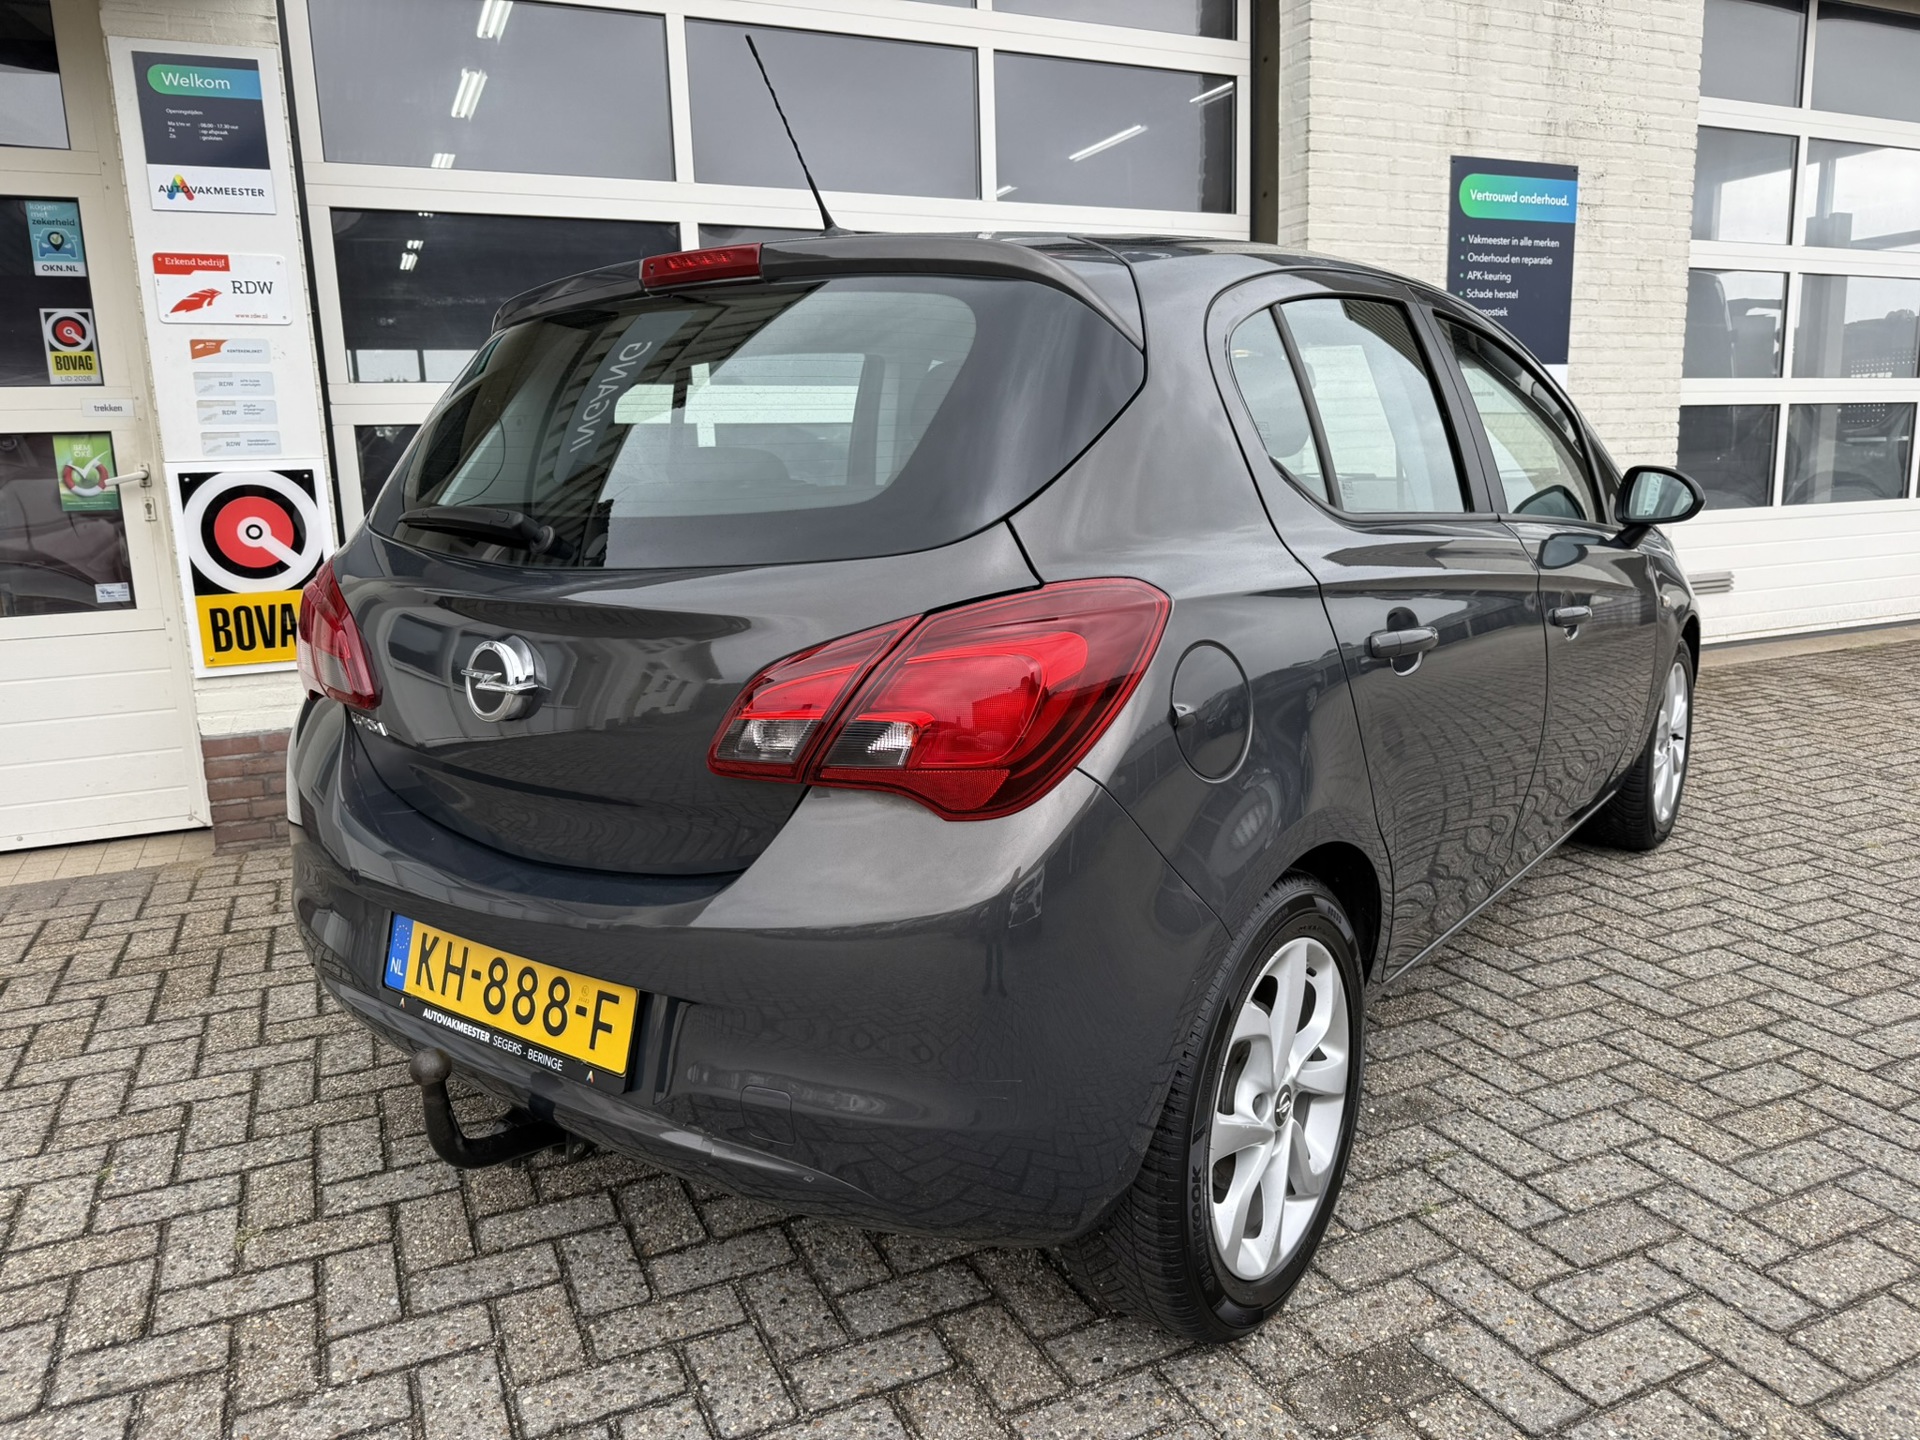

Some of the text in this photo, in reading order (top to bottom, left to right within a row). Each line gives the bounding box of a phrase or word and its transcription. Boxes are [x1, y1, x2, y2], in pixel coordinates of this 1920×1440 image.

[161, 72, 230, 89] Welkom
[158, 184, 265, 197] AUTOVAKMEESTER
[1470, 189, 1569, 206] Vertrouwd onderhoud.
[32, 218, 76, 226] zekerheid
[1468, 234, 1560, 248] Vakmeester in alle merken
[165, 257, 225, 268] Erkend bedrijf
[1467, 252, 1553, 267] Onderhoud en reparatie
[42, 264, 79, 272] OKN.NL
[1466, 270, 1512, 283] APK-keuring
[231, 280, 273, 294] RDW
[1466, 288, 1519, 299] Schade herstel
[54, 355, 93, 370] BOVAG
[94, 404, 123, 412] trekken
[208, 603, 298, 653] BOVA
[390, 957, 404, 977] NL
[415, 932, 621, 1051] KH-888-F
[422, 1008, 490, 1043] AUTOVAKMEESTER
[492, 1034, 523, 1056] SEGERS
[527, 1048, 564, 1071] BERINGE
